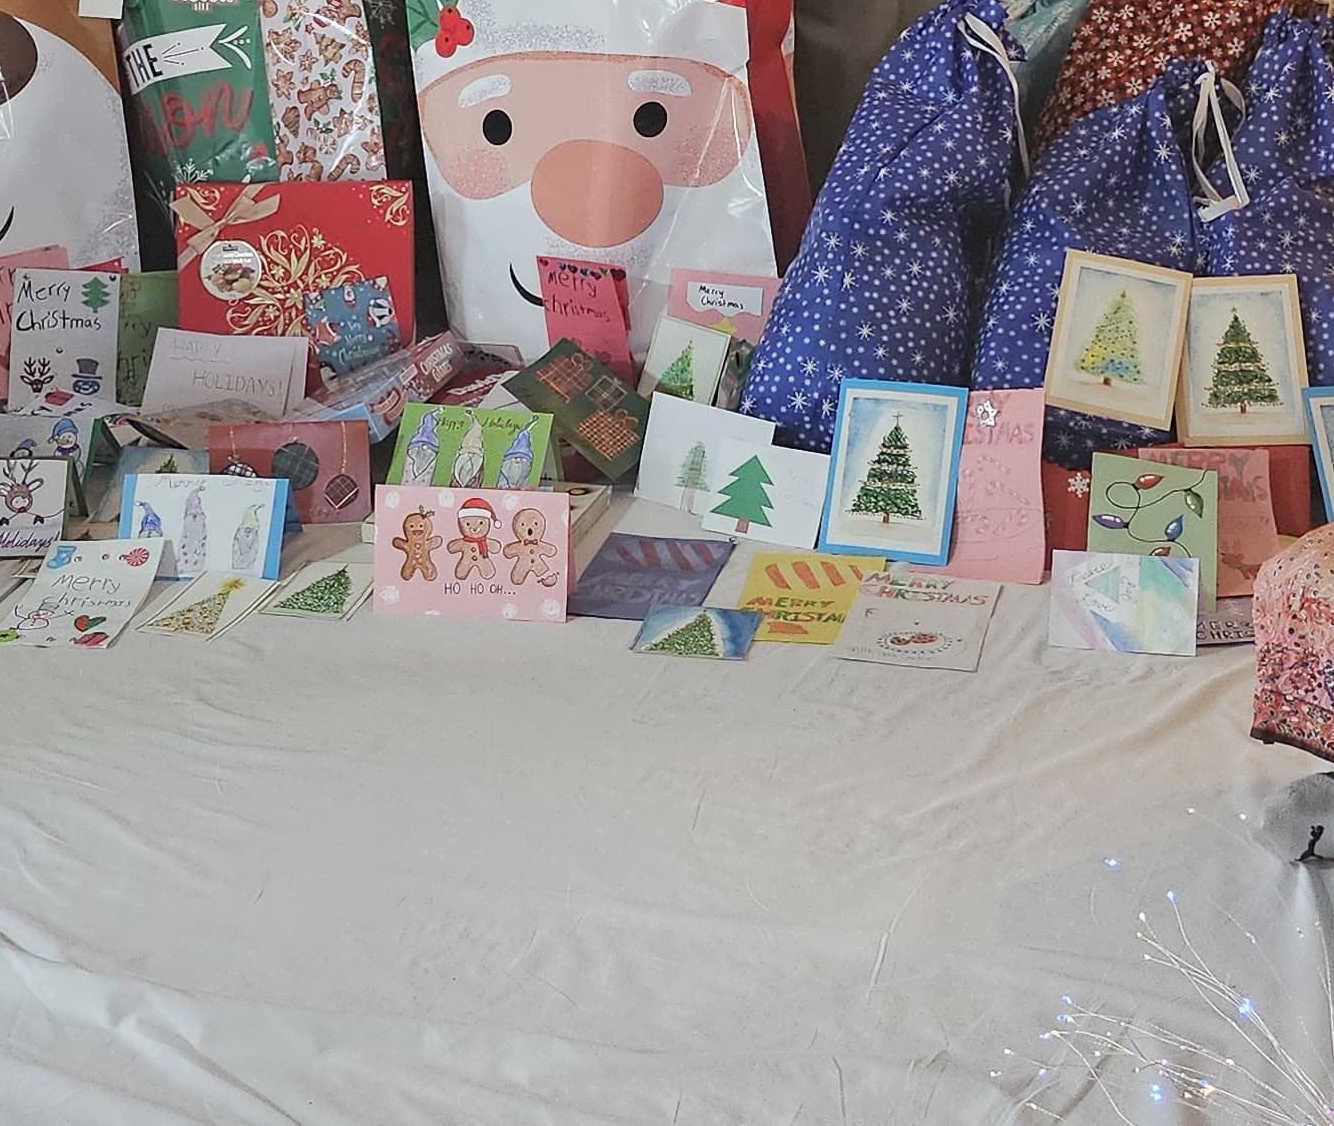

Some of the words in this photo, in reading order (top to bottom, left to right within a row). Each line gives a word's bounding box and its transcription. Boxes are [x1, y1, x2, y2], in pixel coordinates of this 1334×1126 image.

[125, 43, 163, 88] THE
[17, 280, 71, 304] Merry
[698, 285, 725, 299] Merry
[700, 295, 745, 310] Christmas
[864, 572, 956, 590] MERRY
[444, 583, 461, 595] HO
[470, 583, 485, 595] HO
[746, 597, 836, 608] MERRY
